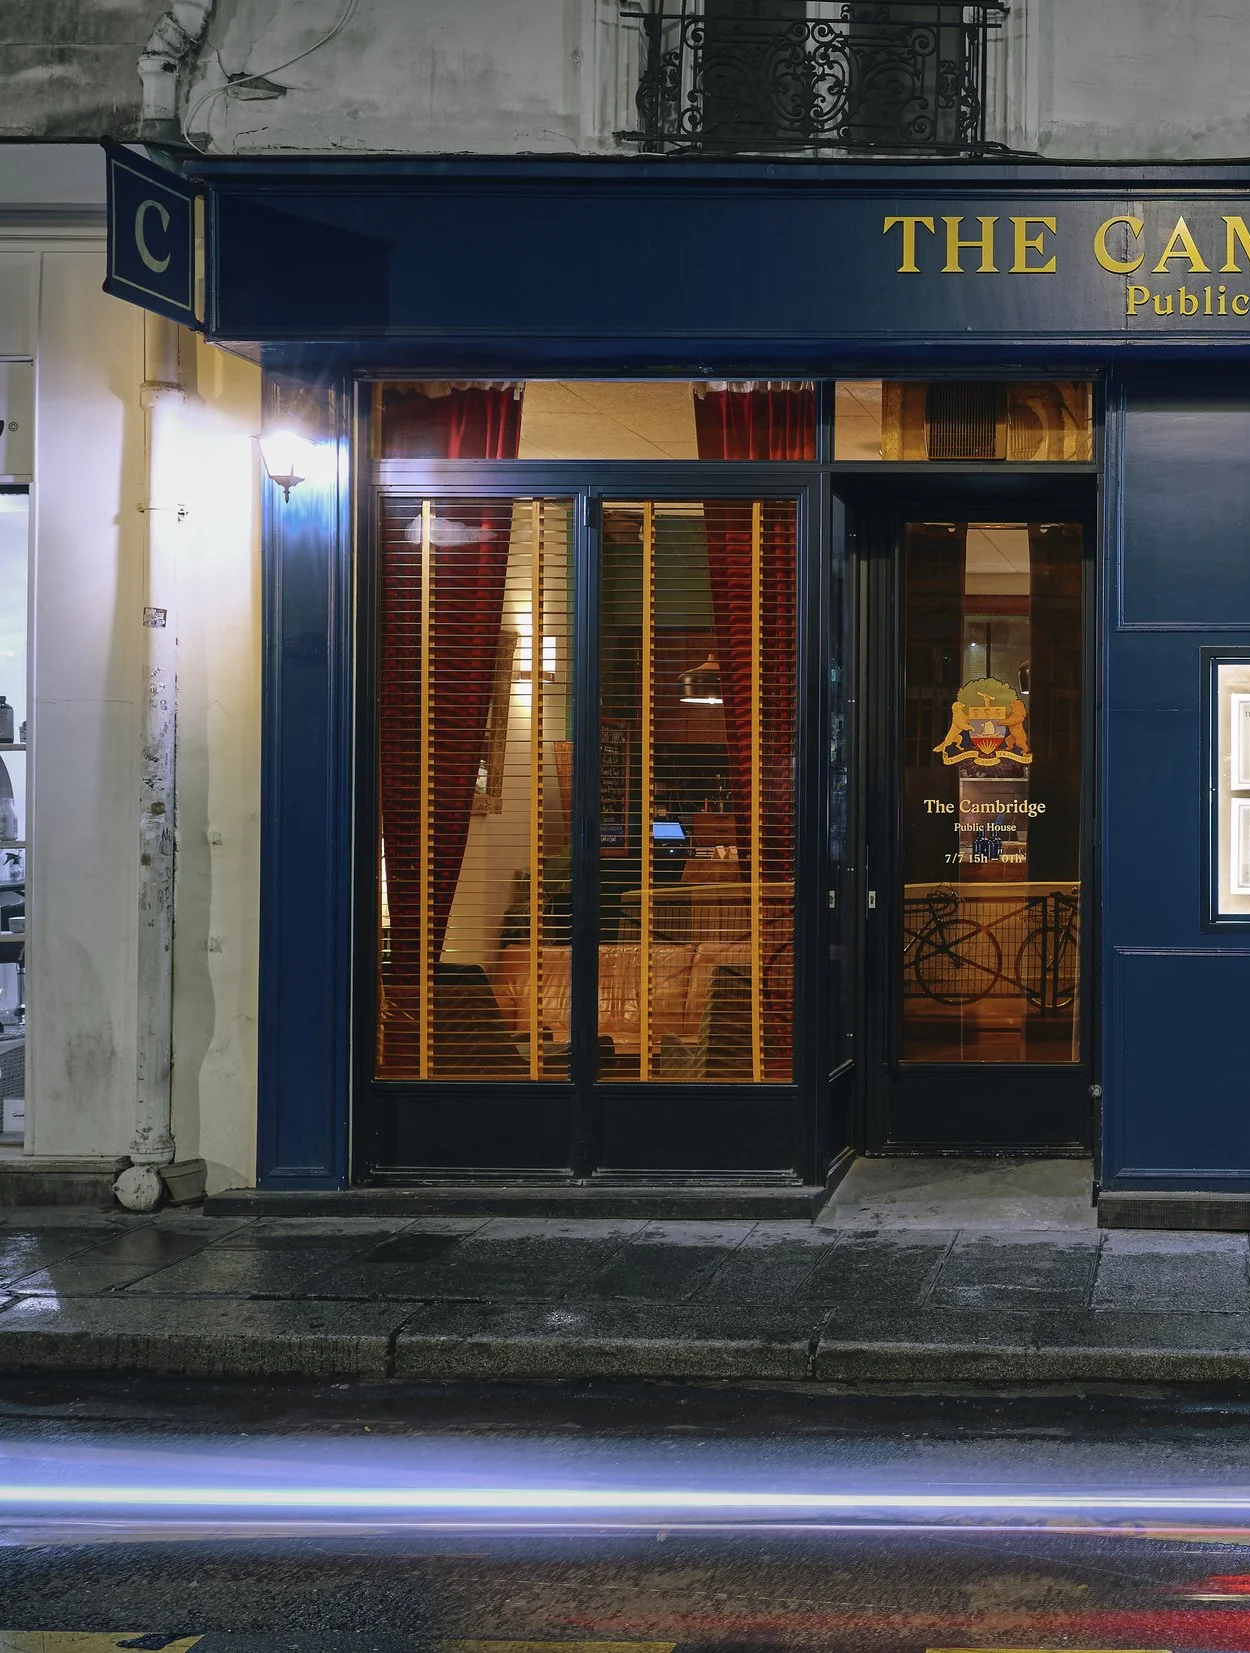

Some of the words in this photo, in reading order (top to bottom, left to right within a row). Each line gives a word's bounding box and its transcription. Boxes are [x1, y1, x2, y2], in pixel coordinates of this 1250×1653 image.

[134, 199, 171, 273] C
[883, 215, 1057, 275] THE
[1126, 284, 1250, 316] Public
[923, 799, 955, 814] The
[959, 799, 1047, 818] Cambridge
[954, 822, 985, 832] Public
[986, 822, 1017, 832] House
[944, 853, 964, 864] 7/7
[968, 853, 988, 864] 15h
